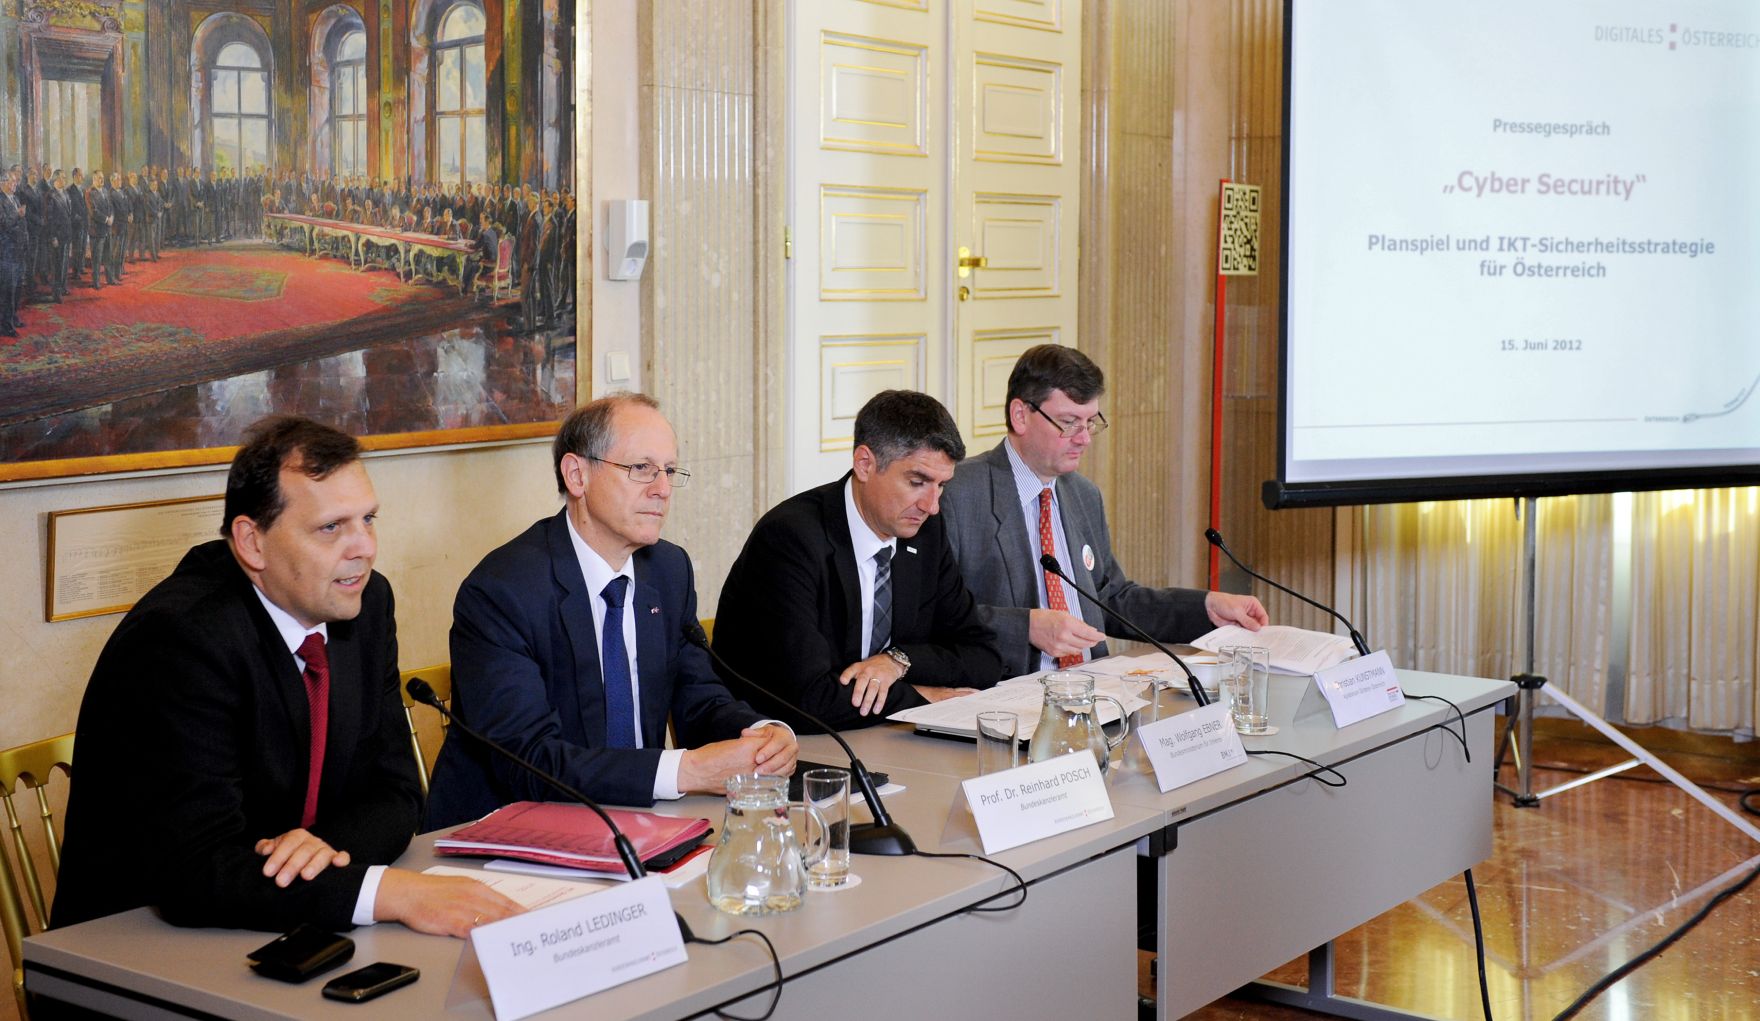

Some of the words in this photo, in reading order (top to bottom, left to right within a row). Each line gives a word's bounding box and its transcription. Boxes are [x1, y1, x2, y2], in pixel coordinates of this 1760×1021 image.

[1594, 25, 1664, 44] DIGITALES
[1492, 118, 1611, 138] Pressegespräch
[1367, 234, 1450, 257] Planspiel
[1456, 235, 1490, 252] und
[1497, 235, 1715, 258] IKT-Sicherheitsstrategie
[1479, 260, 1506, 277] für
[1512, 256, 1607, 278] Österreich
[1500, 339, 1519, 351] 15.
[1522, 339, 1549, 351] Juni
[1552, 339, 1583, 351] 2012
[1176, 727, 1203, 742] Wolfgang
[1202, 720, 1221, 733] EBNER
[980, 790, 1003, 806] Prof.
[1004, 786, 1019, 800] Dr.
[1020, 776, 1060, 795] Reinhard
[1060, 767, 1092, 783] POSCH
[510, 938, 537, 957] Ing.
[539, 923, 583, 946] Roland
[585, 902, 648, 934] LEDINGER
